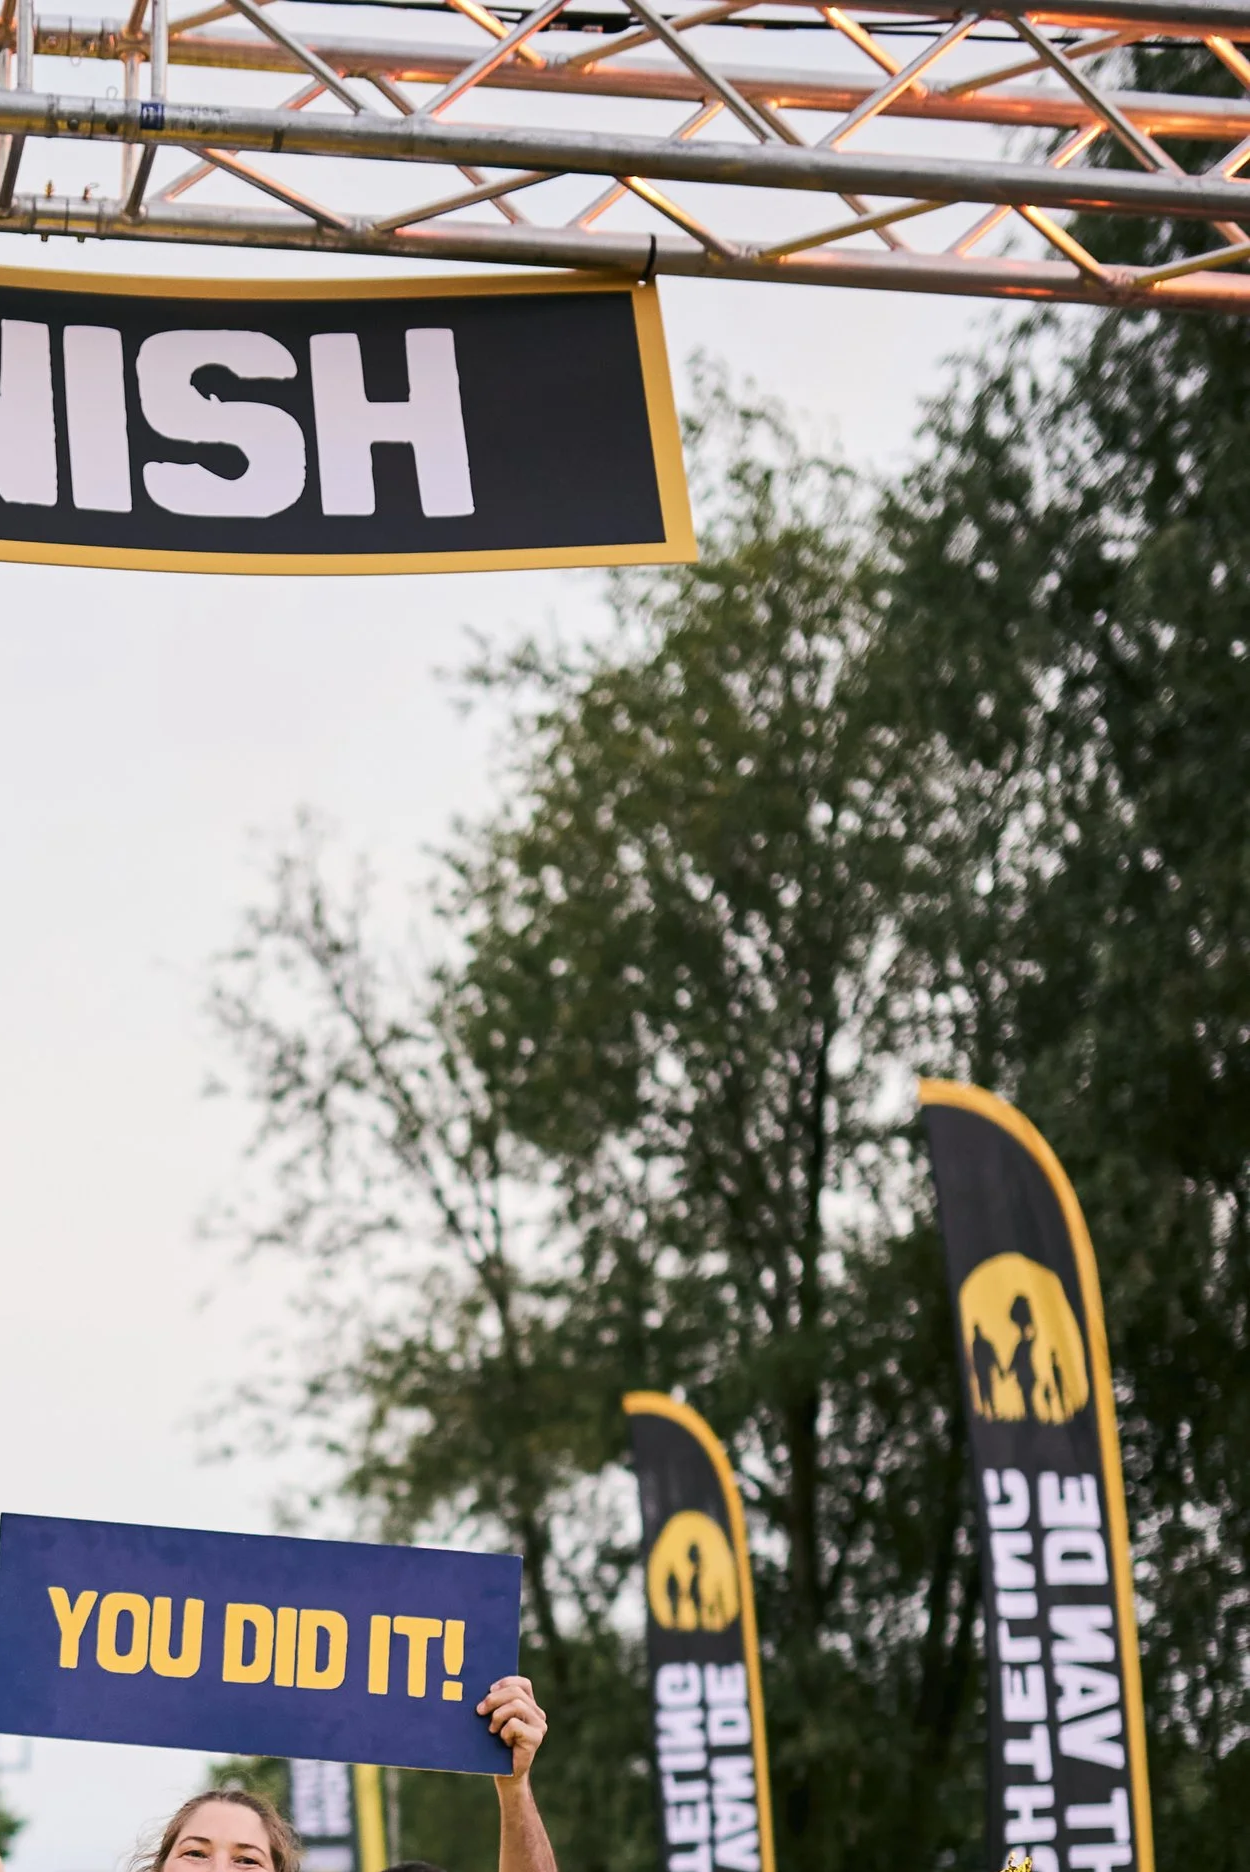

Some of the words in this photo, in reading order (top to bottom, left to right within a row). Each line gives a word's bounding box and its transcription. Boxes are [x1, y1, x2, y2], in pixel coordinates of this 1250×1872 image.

[48, 1587, 204, 1679] YOU
[222, 1602, 348, 1691] DID
[368, 1614, 466, 1702] IT!
